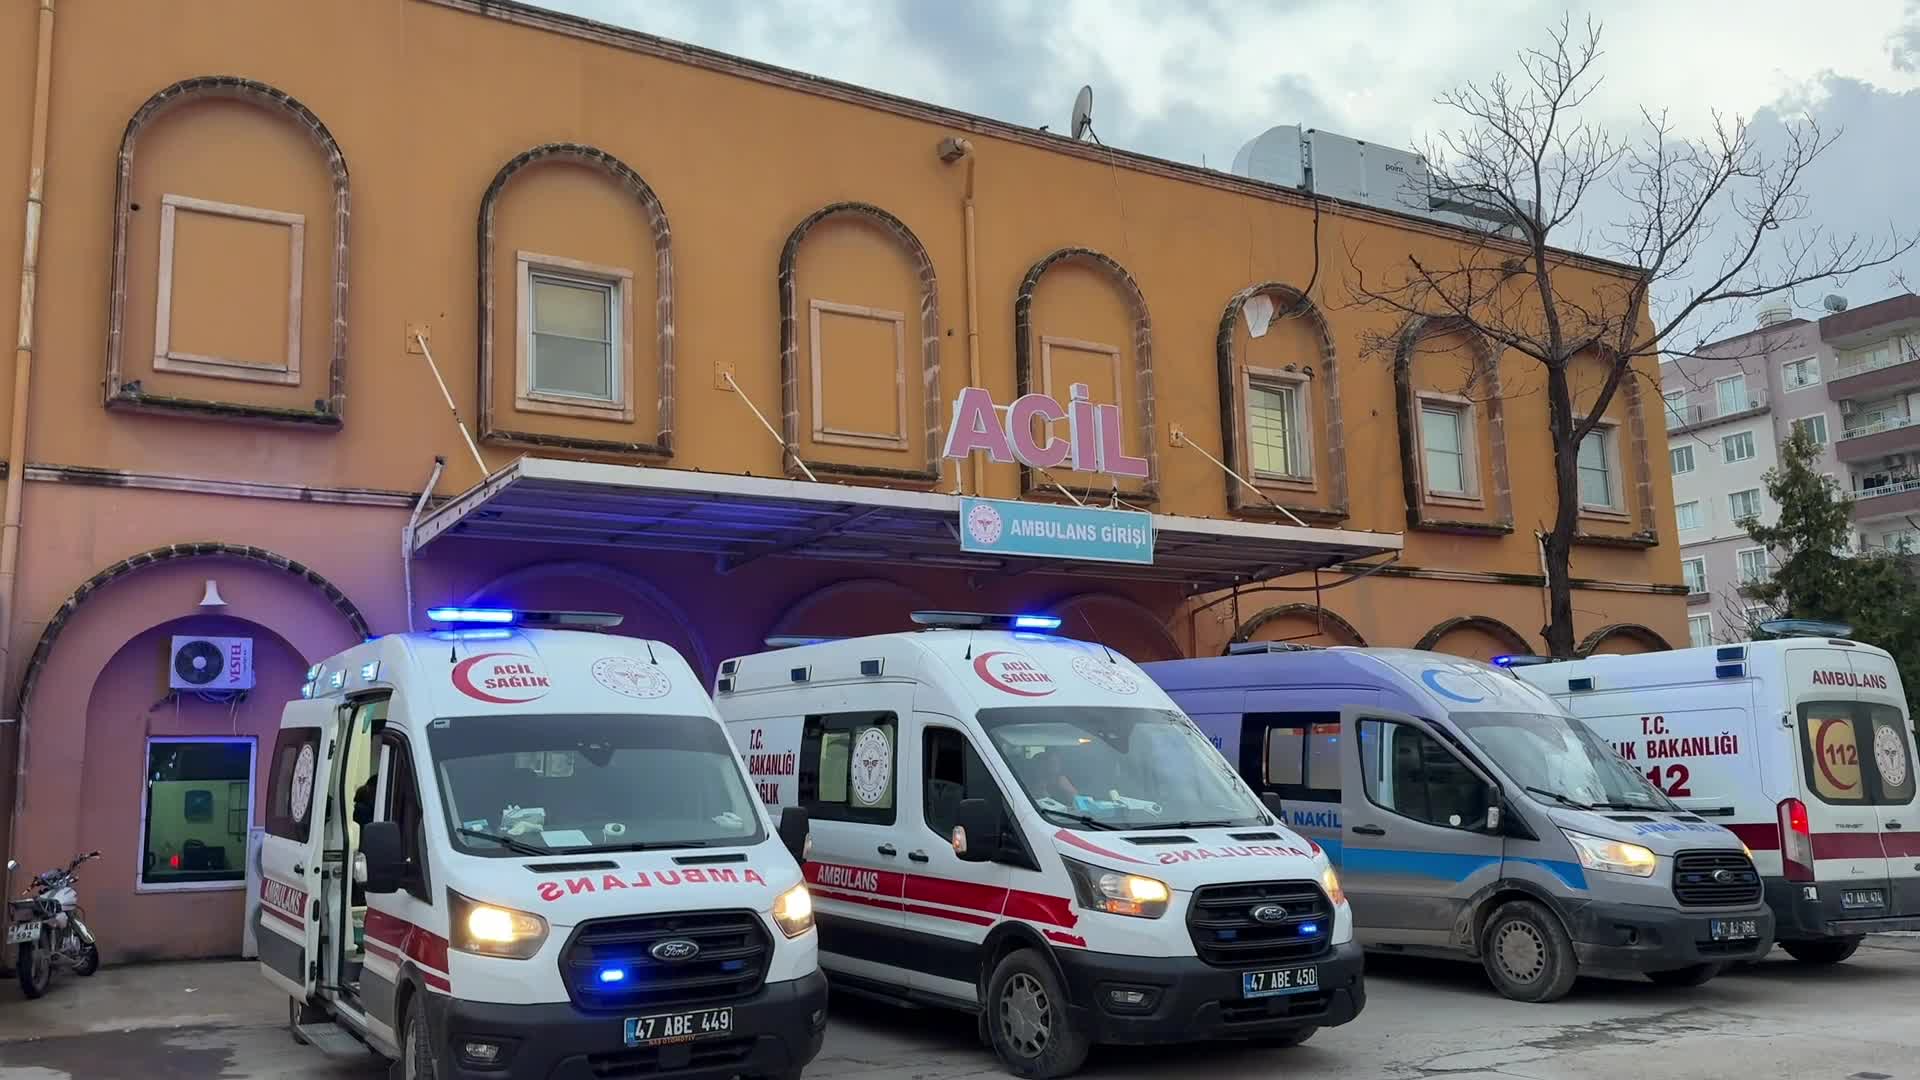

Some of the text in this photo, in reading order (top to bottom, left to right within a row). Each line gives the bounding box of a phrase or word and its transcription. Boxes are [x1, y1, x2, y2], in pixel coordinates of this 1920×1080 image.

[942, 383, 1149, 477] ACİL
[1010, 519, 1146, 549] AMBULANS GİRİŞİ
[230, 642, 241, 683] VESTEL
[494, 663, 534, 675] ACİL
[484, 675, 551, 689] SAĞLIK
[1001, 671, 1053, 683] SAĞLIK
[1812, 670, 1887, 690] AMBULANS
[1641, 716, 1669, 735] T.C.
[749, 729, 763, 750] T.C.
[1647, 731, 1738, 759] BAKANLIĞI
[749, 748, 796, 776] BAKANLIĞI
[1826, 743, 1858, 766] 112
[1636, 764, 1692, 798] 12
[1294, 811, 1342, 828] NAKİL
[817, 864, 878, 891] AMBULANS
[264, 879, 303, 914] AMBULANS
[664, 943, 690, 957] Ford
[1251, 968, 1315, 991] 47 ABE 450
[635, 1010, 729, 1039] 47 ABE 449
